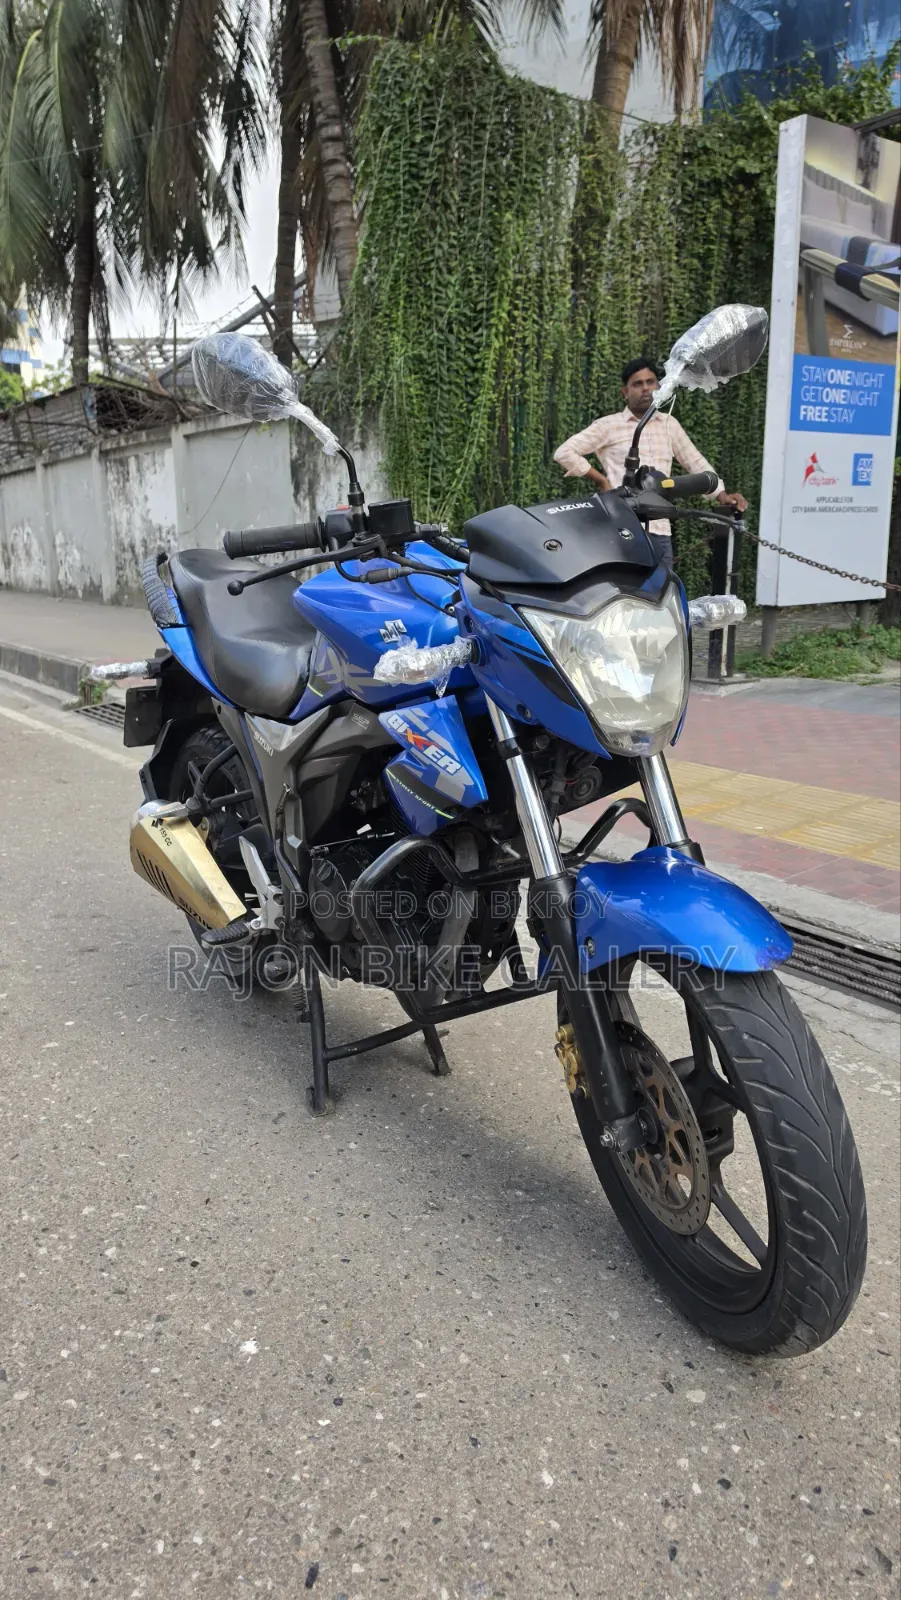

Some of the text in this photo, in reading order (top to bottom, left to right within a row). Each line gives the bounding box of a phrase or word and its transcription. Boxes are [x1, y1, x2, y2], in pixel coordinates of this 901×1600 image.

[800, 405, 855, 424] FREE STAY
[546, 502, 594, 515] SUZUKI
[253, 731, 274, 757] SUZUKI
[159, 827, 173, 847] 155 CC
